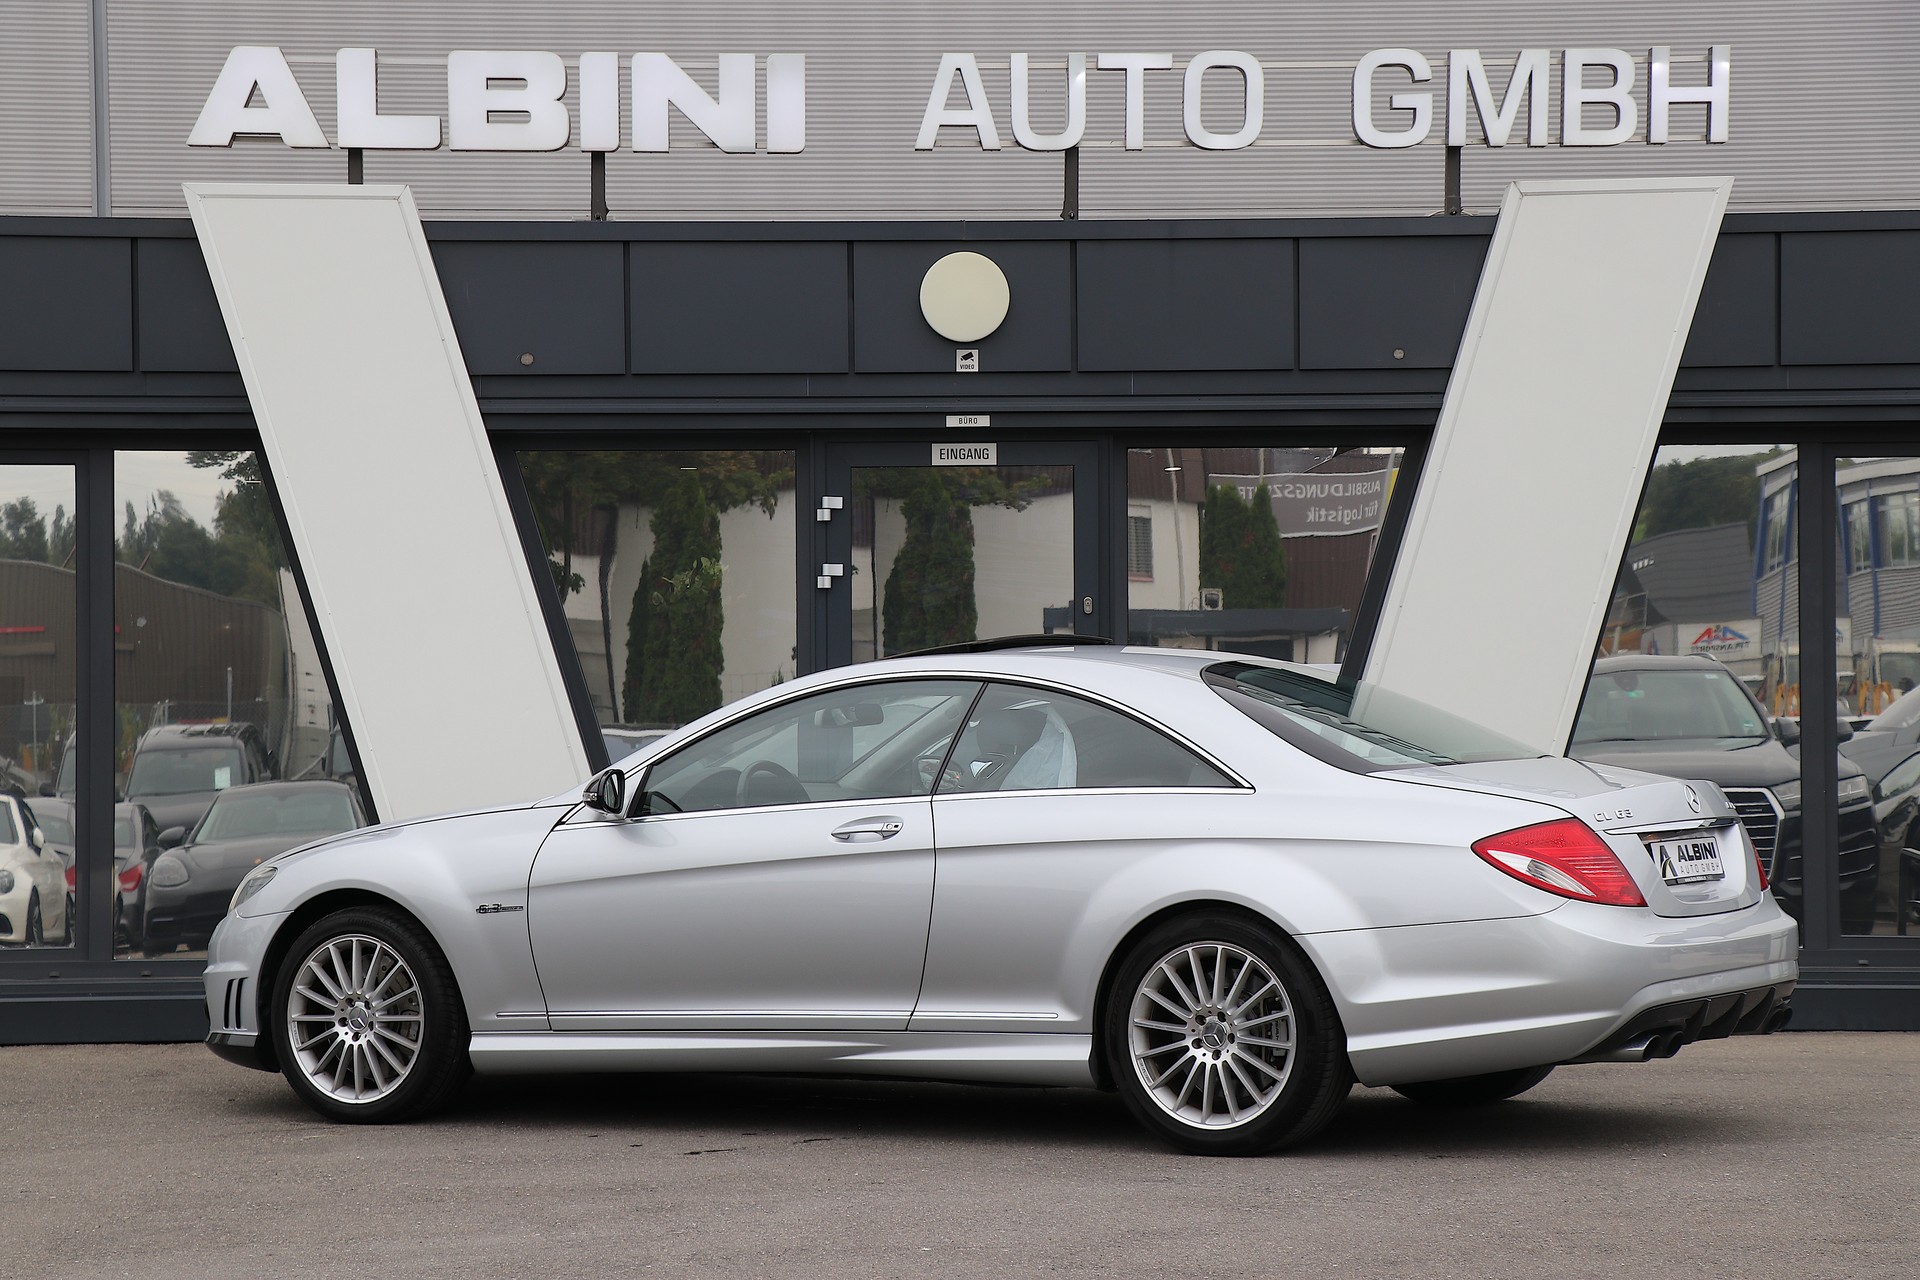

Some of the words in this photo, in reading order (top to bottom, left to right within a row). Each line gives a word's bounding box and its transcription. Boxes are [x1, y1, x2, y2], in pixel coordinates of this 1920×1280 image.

[186, 45, 806, 154] ALBINI
[914, 49, 1265, 152] AUTO
[1351, 44, 1731, 149] GMBH
[958, 416, 978, 425] BÜRO
[939, 448, 990, 460] EINGANG
[1593, 812, 1612, 822] CL
[1614, 808, 1633, 819] 63
[1677, 842, 1717, 862] ALBINI
[1680, 864, 1699, 874] AUTO
